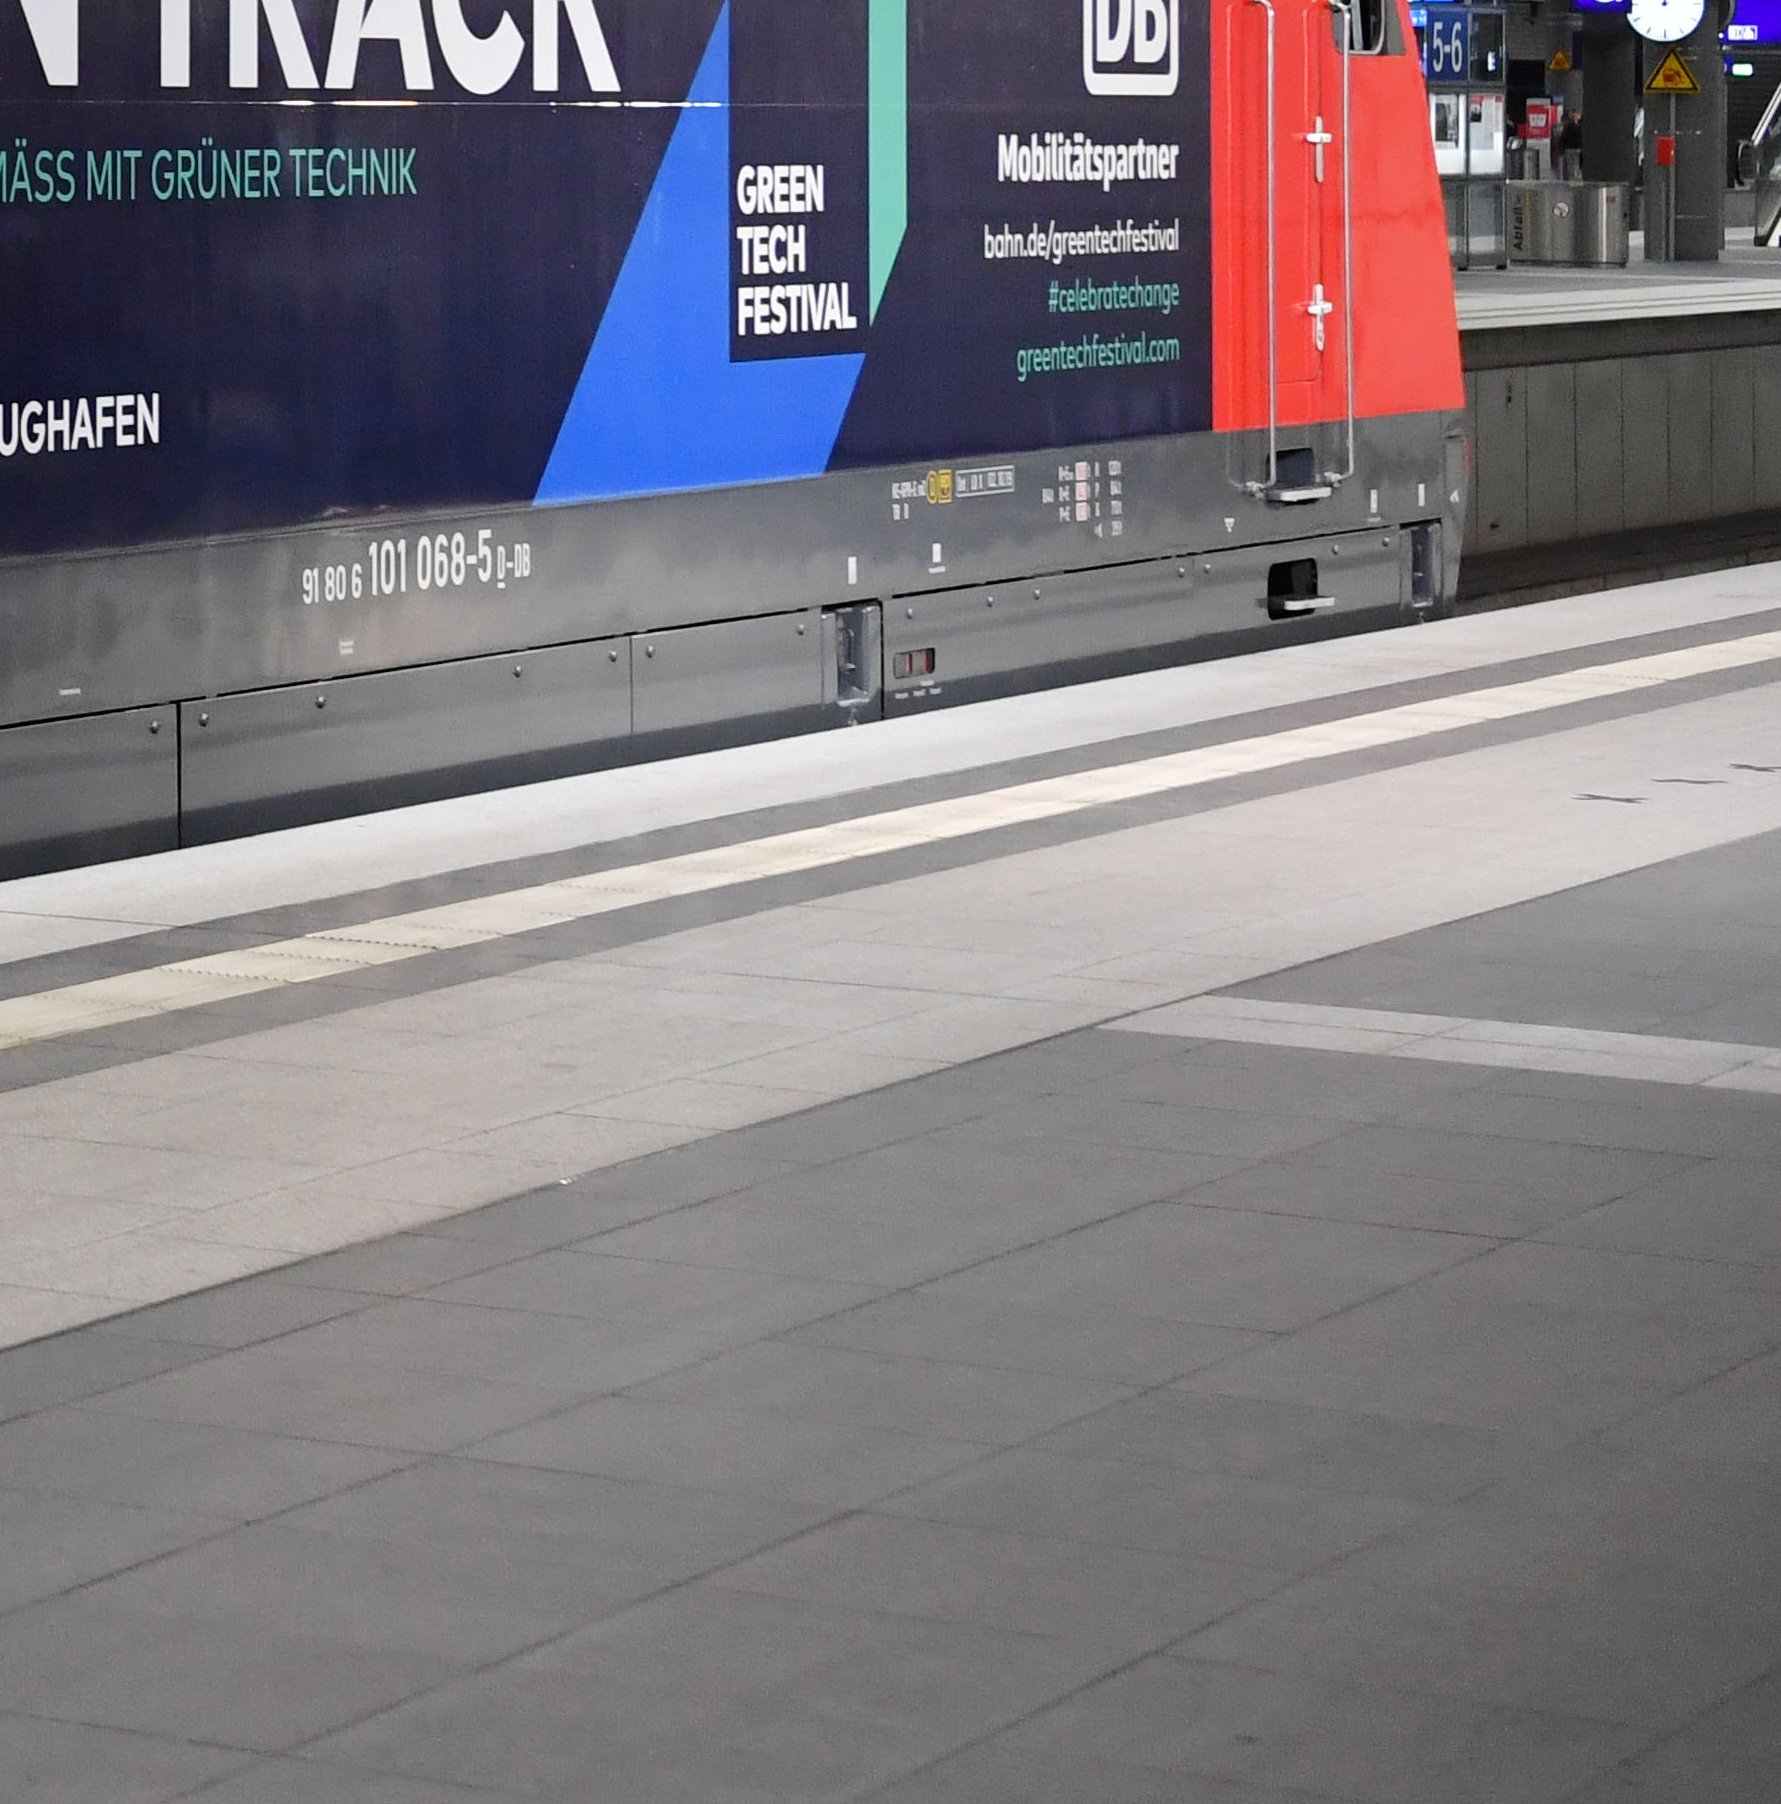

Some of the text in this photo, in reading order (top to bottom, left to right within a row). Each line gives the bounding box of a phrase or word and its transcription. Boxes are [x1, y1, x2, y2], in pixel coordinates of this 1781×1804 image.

[1432, 21, 1463, 73] 5-6
[87, 149, 142, 201] MIT
[151, 137, 281, 199] GRÜNER
[289, 146, 418, 197] TECHNIK
[997, 132, 1180, 192] Mobilitätspartner
[737, 164, 825, 214] GREEN
[737, 225, 806, 275] TECH
[983, 218, 1180, 266] bahn.de/greentechfestival
[737, 282, 857, 335] FESTIVAL
[1048, 275, 1180, 313] #celebratechange
[1017, 331, 1180, 383] greentechfestival.com
[302, 528, 531, 605] 91 80 6 101 068-5 D-DB
